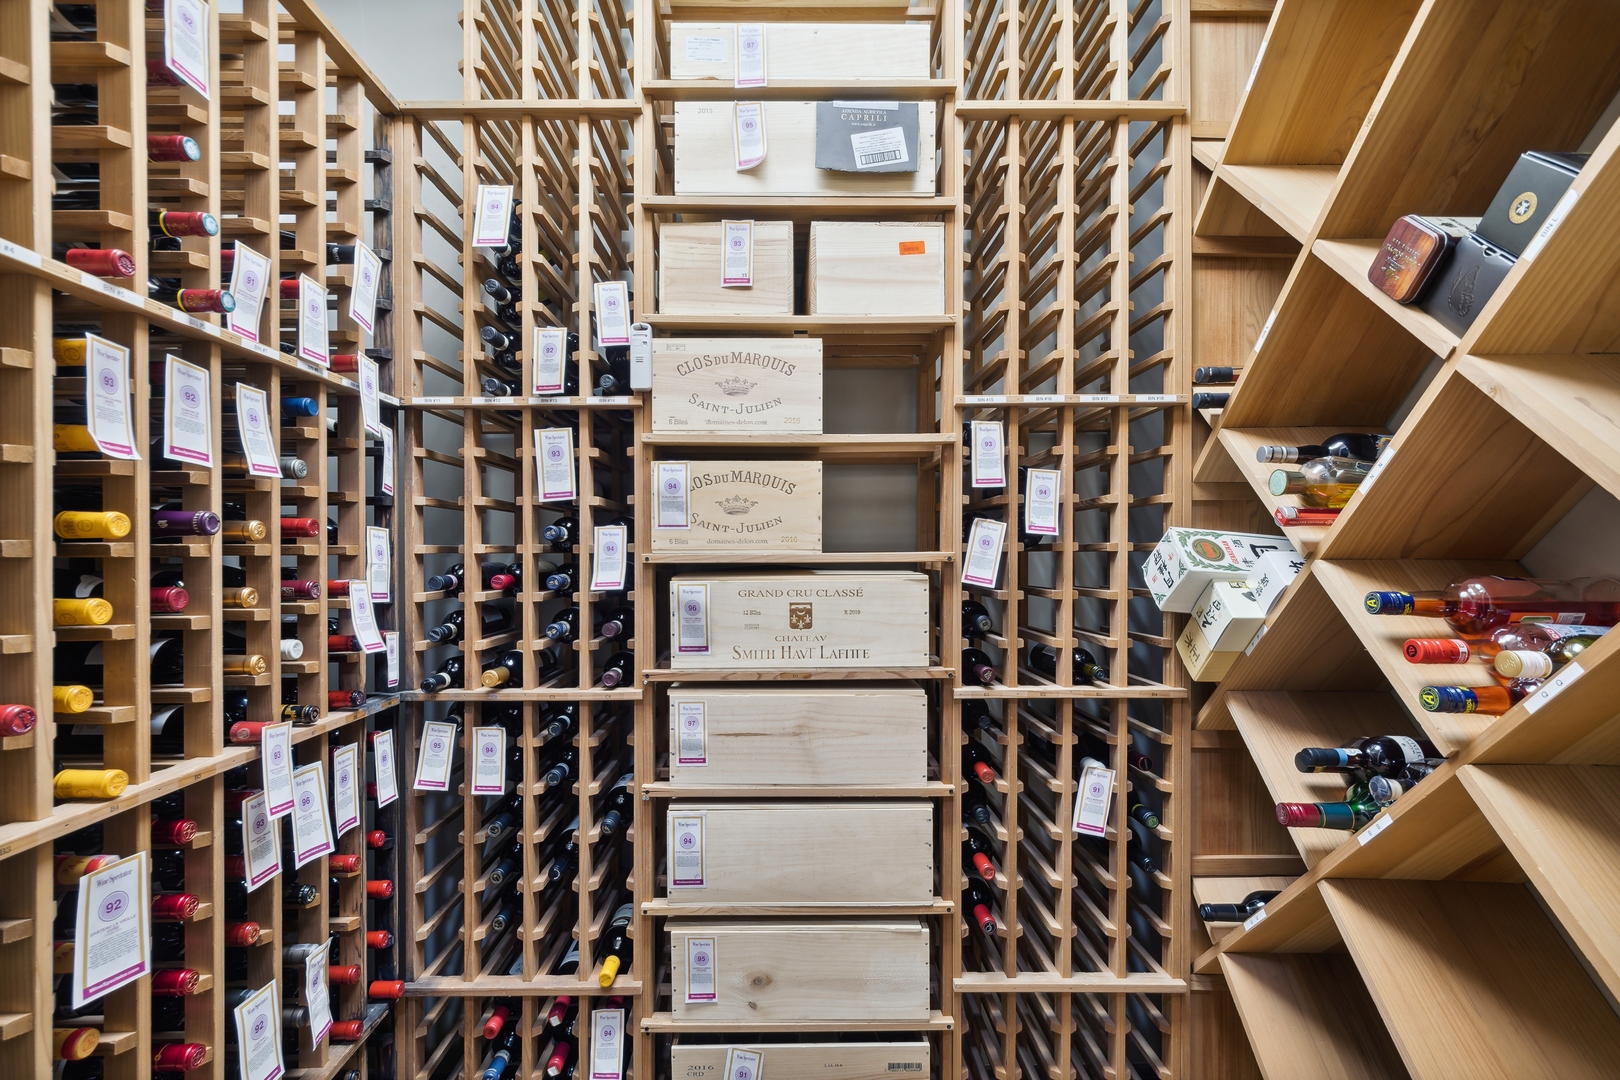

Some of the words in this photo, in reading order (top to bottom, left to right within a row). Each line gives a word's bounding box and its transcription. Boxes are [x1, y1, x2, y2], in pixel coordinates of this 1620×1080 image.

[840, 114, 888, 122] CAPRILI
[1541, 223, 1554, 238] BIN
[246, 276, 255, 286] 91
[103, 284, 116, 294] BIN
[311, 304, 318, 314] 97
[676, 354, 713, 377] CLOS
[714, 355, 729, 366] DU
[730, 351, 796, 376] MARQUIS
[104, 376, 114, 388] 93
[184, 392, 196, 402] 92
[688, 392, 782, 414] SAINT-JULIEN
[250, 414, 258, 423] 94
[714, 474, 729, 484] DU
[730, 470, 796, 496] MARQUIS
[690, 512, 783, 534] SAINT-JULIEN
[1221, 540, 1240, 565] GEKKEIKAN
[816, 587, 864, 597] CLASSÉ
[732, 645, 776, 660] SMITH
[781, 646, 816, 660] HAVT
[274, 750, 281, 760] 93
[340, 774, 348, 784] 95
[302, 796, 311, 806] 96
[110, 804, 119, 812] B4
[256, 818, 265, 829] 93
[105, 899, 122, 914] 92
[254, 1020, 264, 1034] 92
